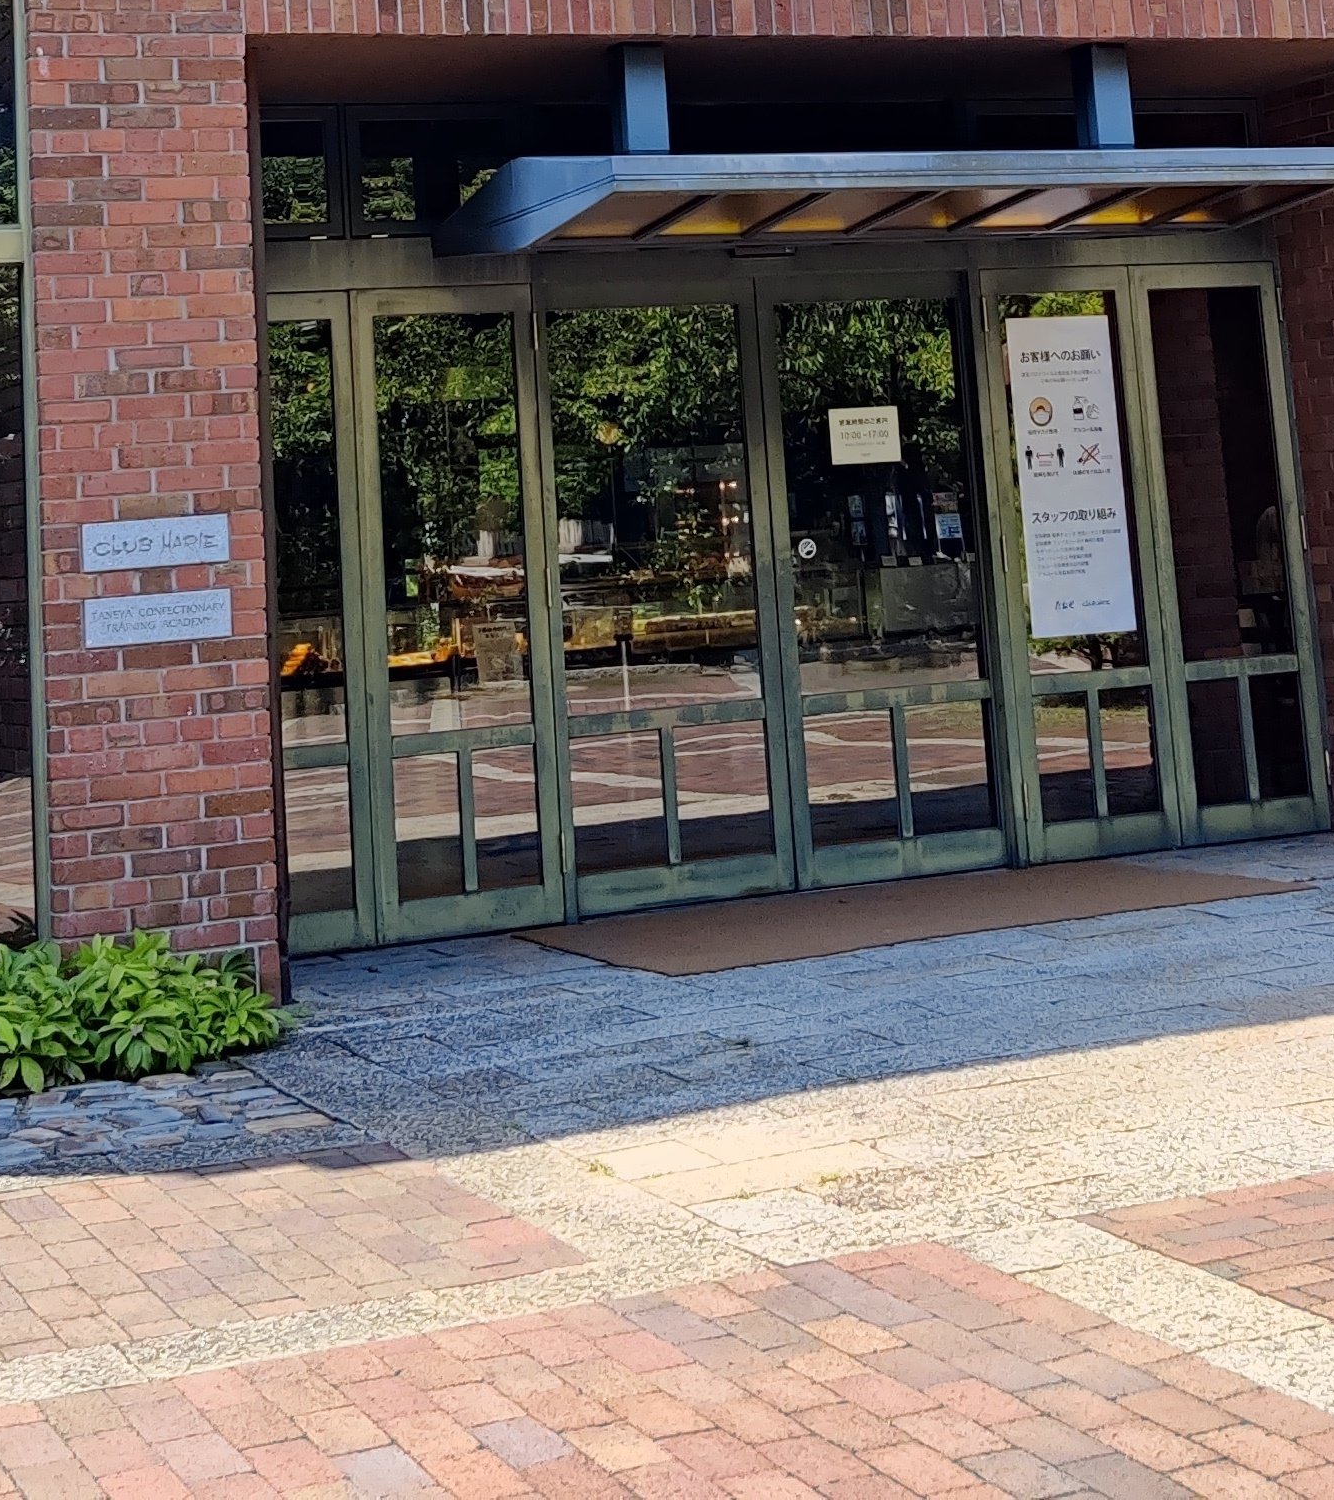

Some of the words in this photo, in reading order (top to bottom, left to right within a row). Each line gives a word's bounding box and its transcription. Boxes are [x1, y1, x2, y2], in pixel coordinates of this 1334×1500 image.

[1020, 349, 1101, 363] お客様へのお願い
[1032, 507, 1116, 524] スタッフの取り組み
[93, 534, 153, 557] CLUB
[161, 529, 218, 555] HARIE
